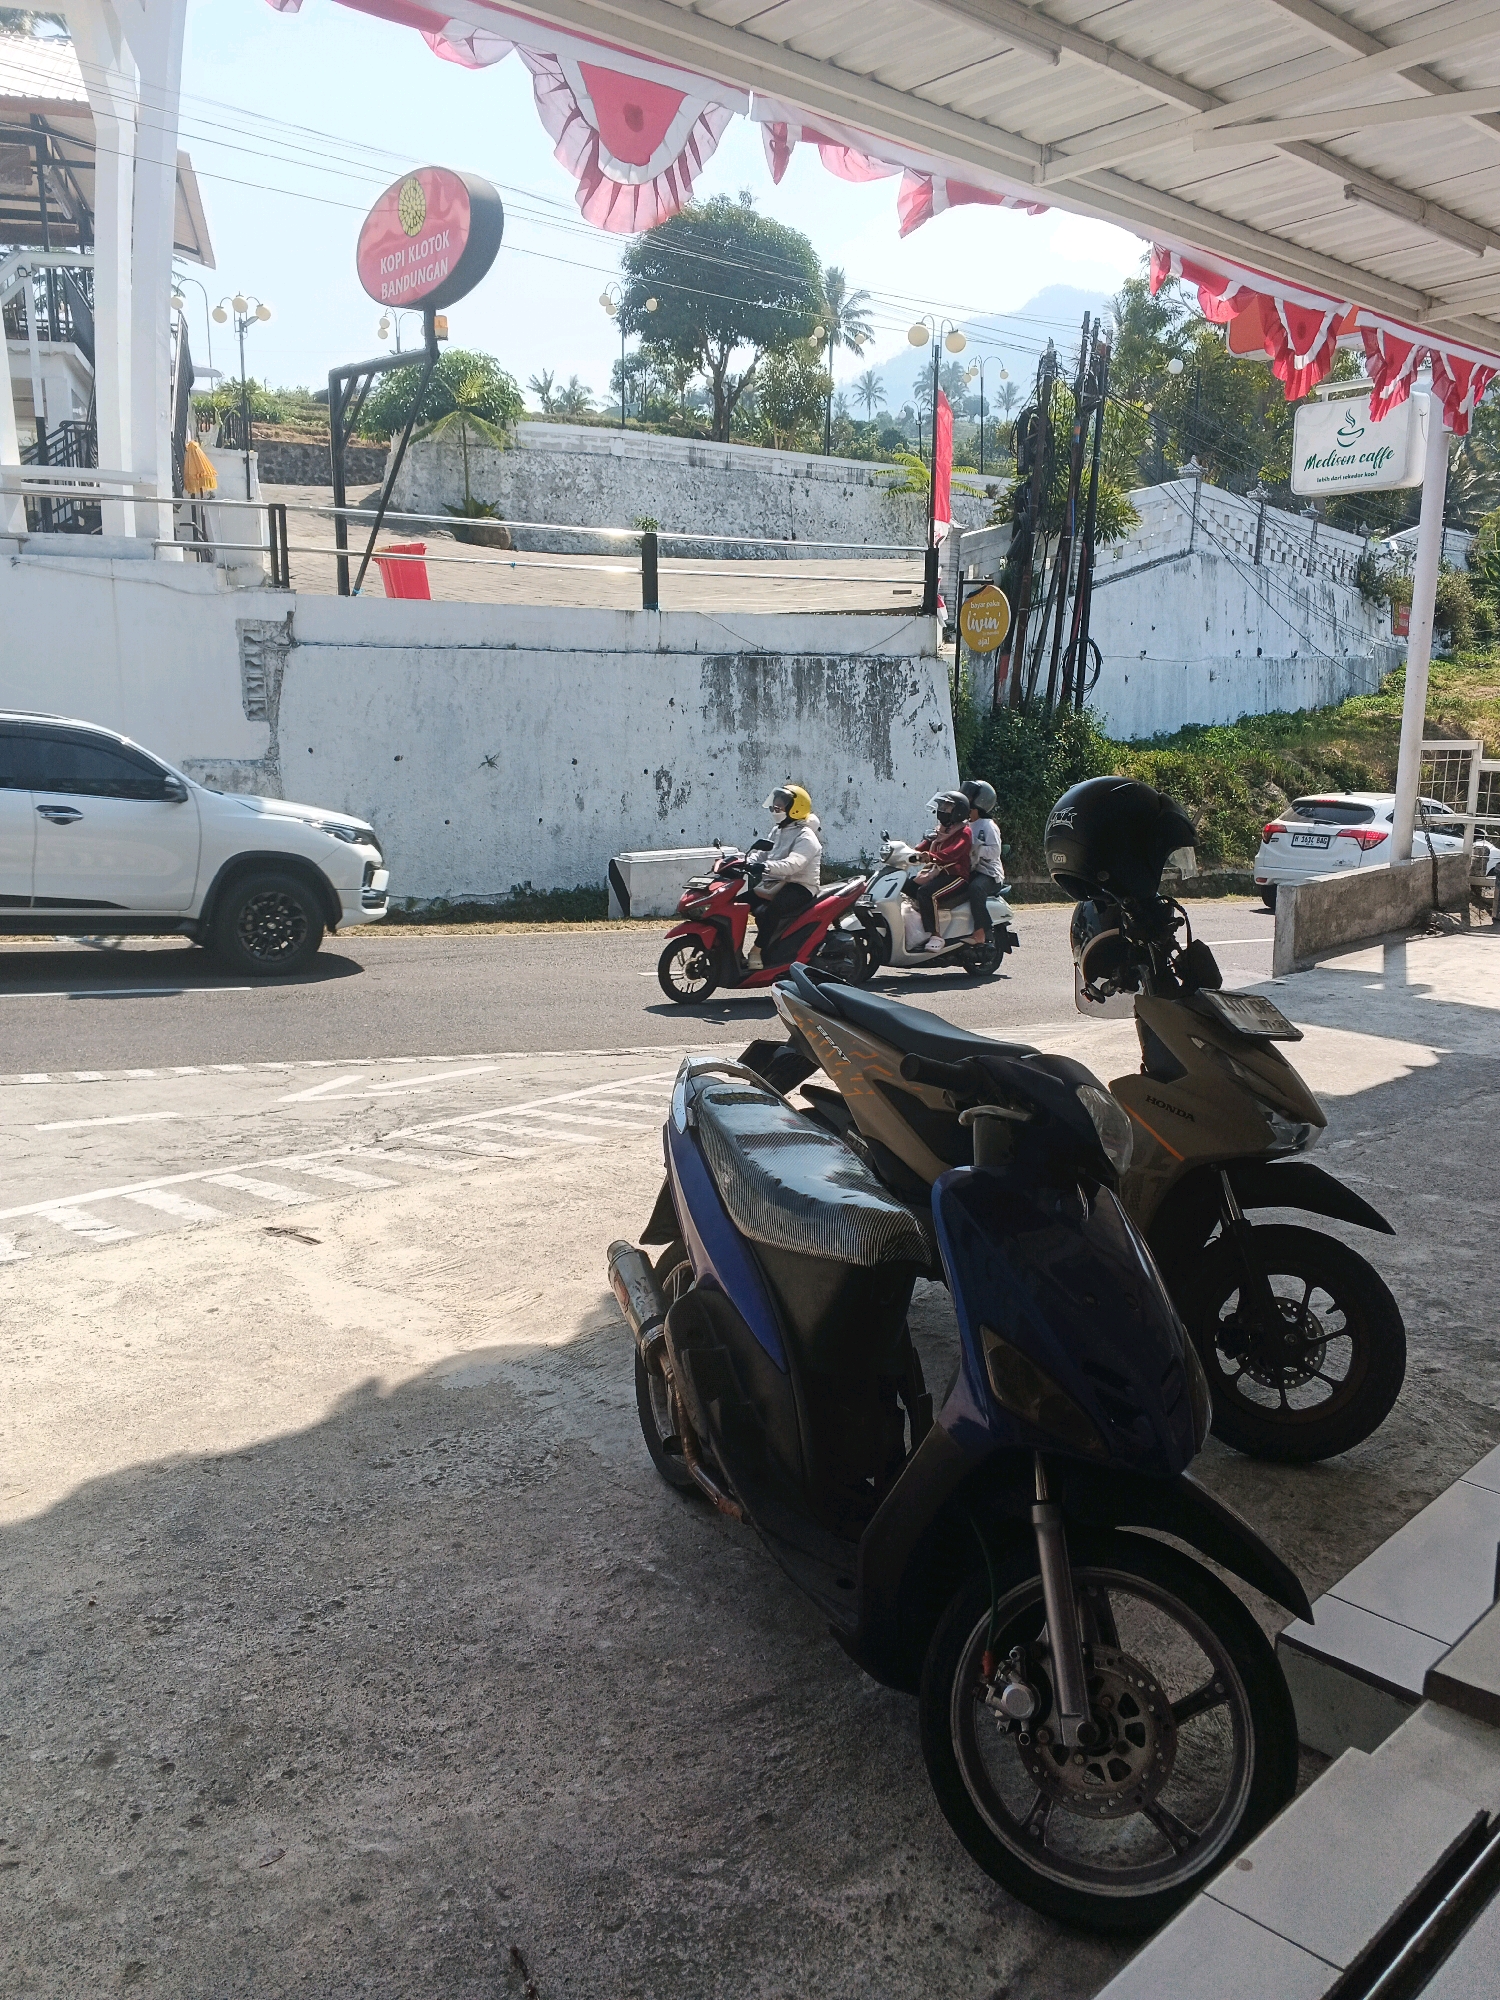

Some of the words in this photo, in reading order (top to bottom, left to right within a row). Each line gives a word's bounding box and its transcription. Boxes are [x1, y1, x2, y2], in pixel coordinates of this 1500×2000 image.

[380, 249, 405, 275] KOPI
[408, 229, 450, 264] KLOTOK
[381, 257, 449, 300] BANDUNGAN
[1303, 449, 1356, 471] Medison
[1359, 446, 1395, 470] caffe
[1145, 1094, 1195, 1122] HONDA
